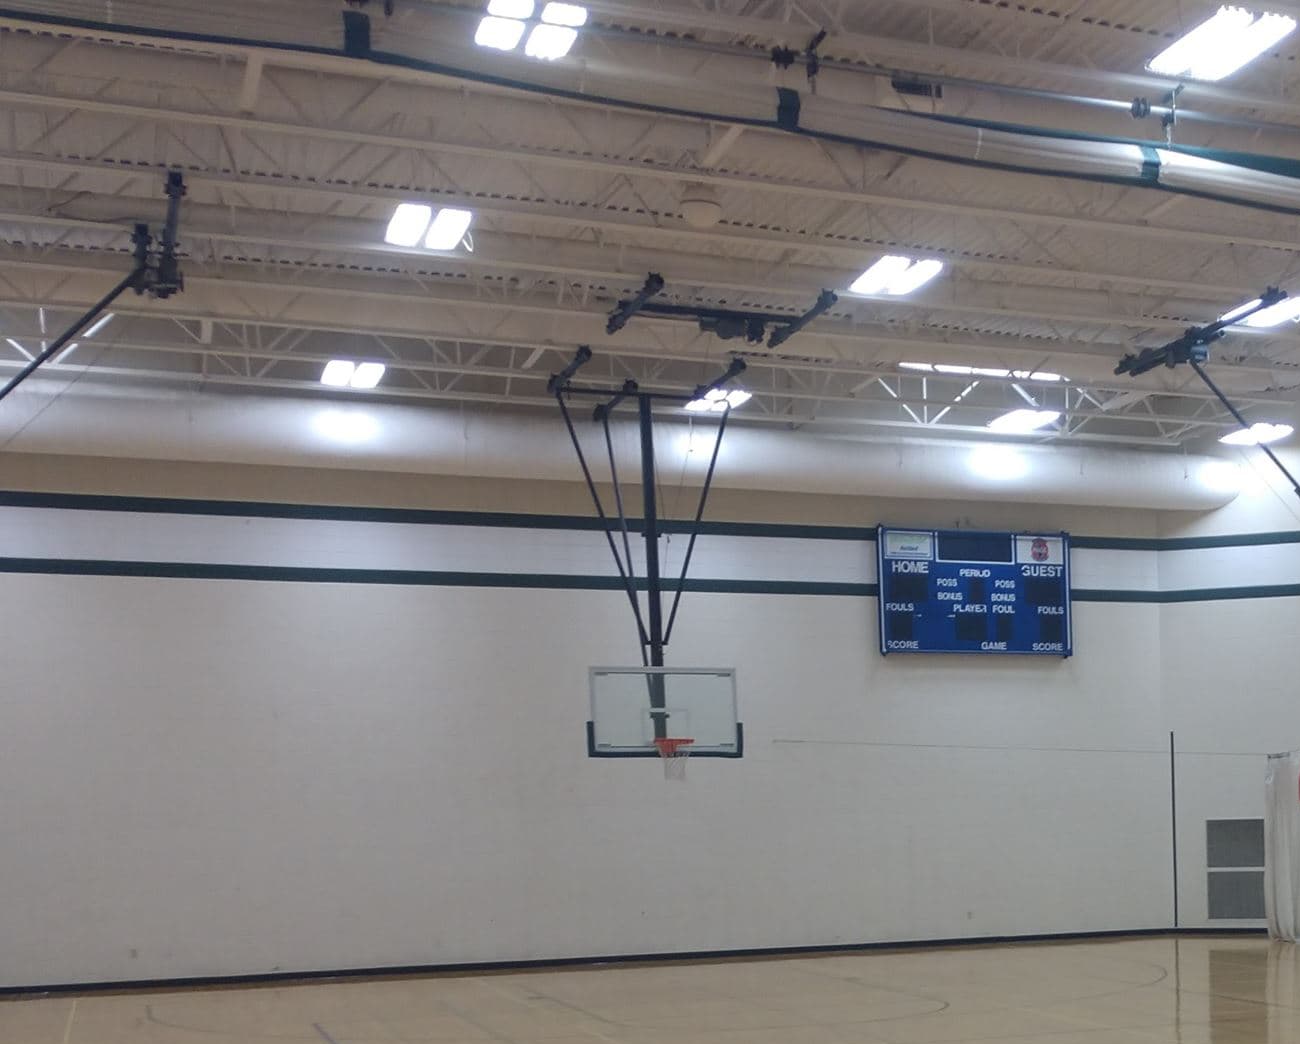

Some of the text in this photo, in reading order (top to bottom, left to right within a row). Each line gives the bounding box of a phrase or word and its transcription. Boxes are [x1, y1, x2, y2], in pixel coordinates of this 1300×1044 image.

[892, 561, 929, 574] HOME
[1021, 565, 1063, 577] GUEST
[936, 578, 958, 587] POSS
[995, 580, 1015, 589] POSS
[937, 592, 963, 601] BONUS
[991, 593, 1016, 602] BONUS
[885, 603, 914, 612] FOULS
[1038, 606, 1064, 615] FOULS
[887, 640, 919, 649] SCORE
[981, 642, 1007, 650] GAME
[1032, 643, 1063, 651] SCORE
